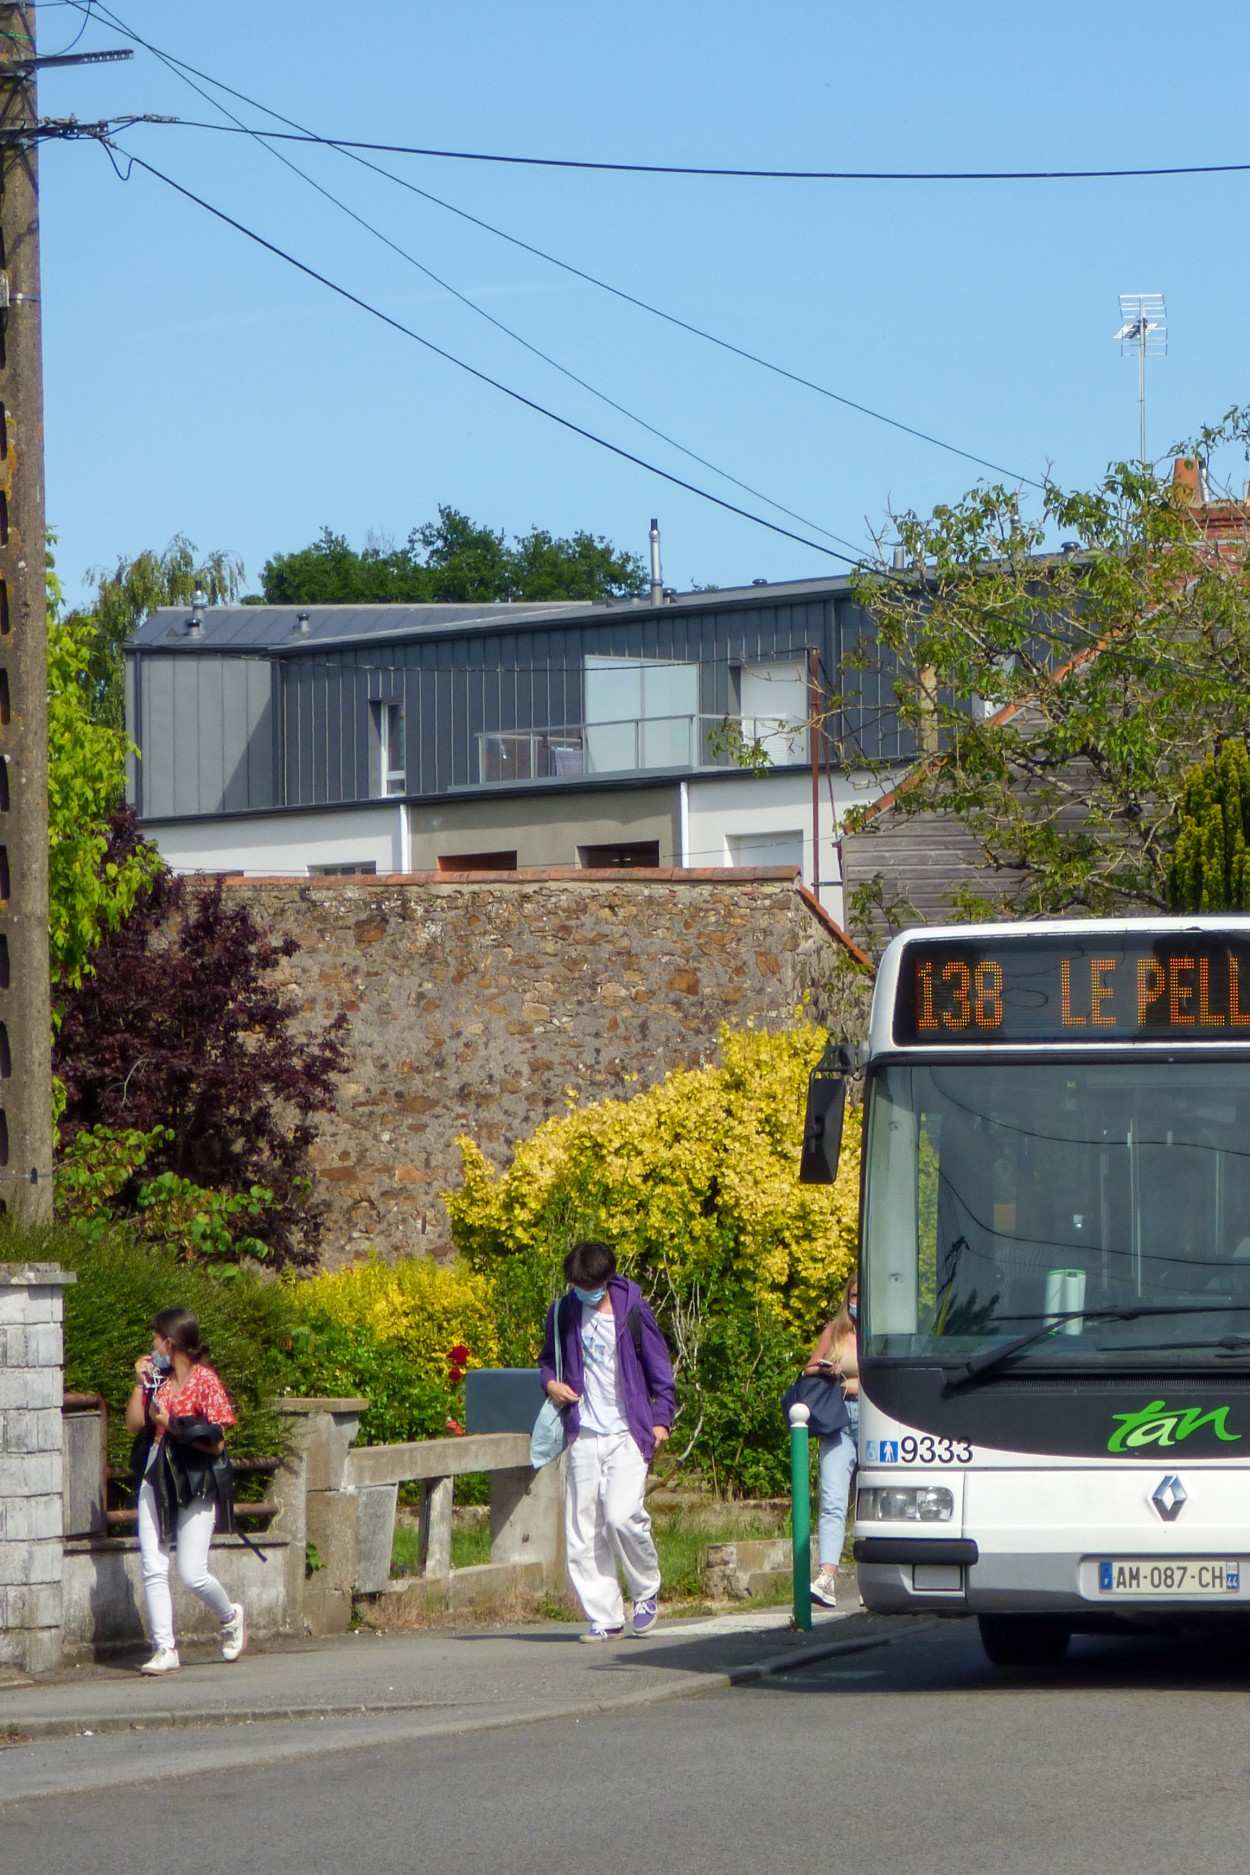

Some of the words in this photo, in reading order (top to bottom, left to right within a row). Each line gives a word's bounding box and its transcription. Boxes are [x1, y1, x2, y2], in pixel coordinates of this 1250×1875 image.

[916, 960, 1003, 1031] 138
[1060, 957, 1117, 1028] LE
[1107, 1400, 1242, 1453] tan
[901, 1435, 974, 1464] 9333
[1116, 1566, 1223, 1589] AM-087-CH
[1226, 1576, 1238, 1588] 44
